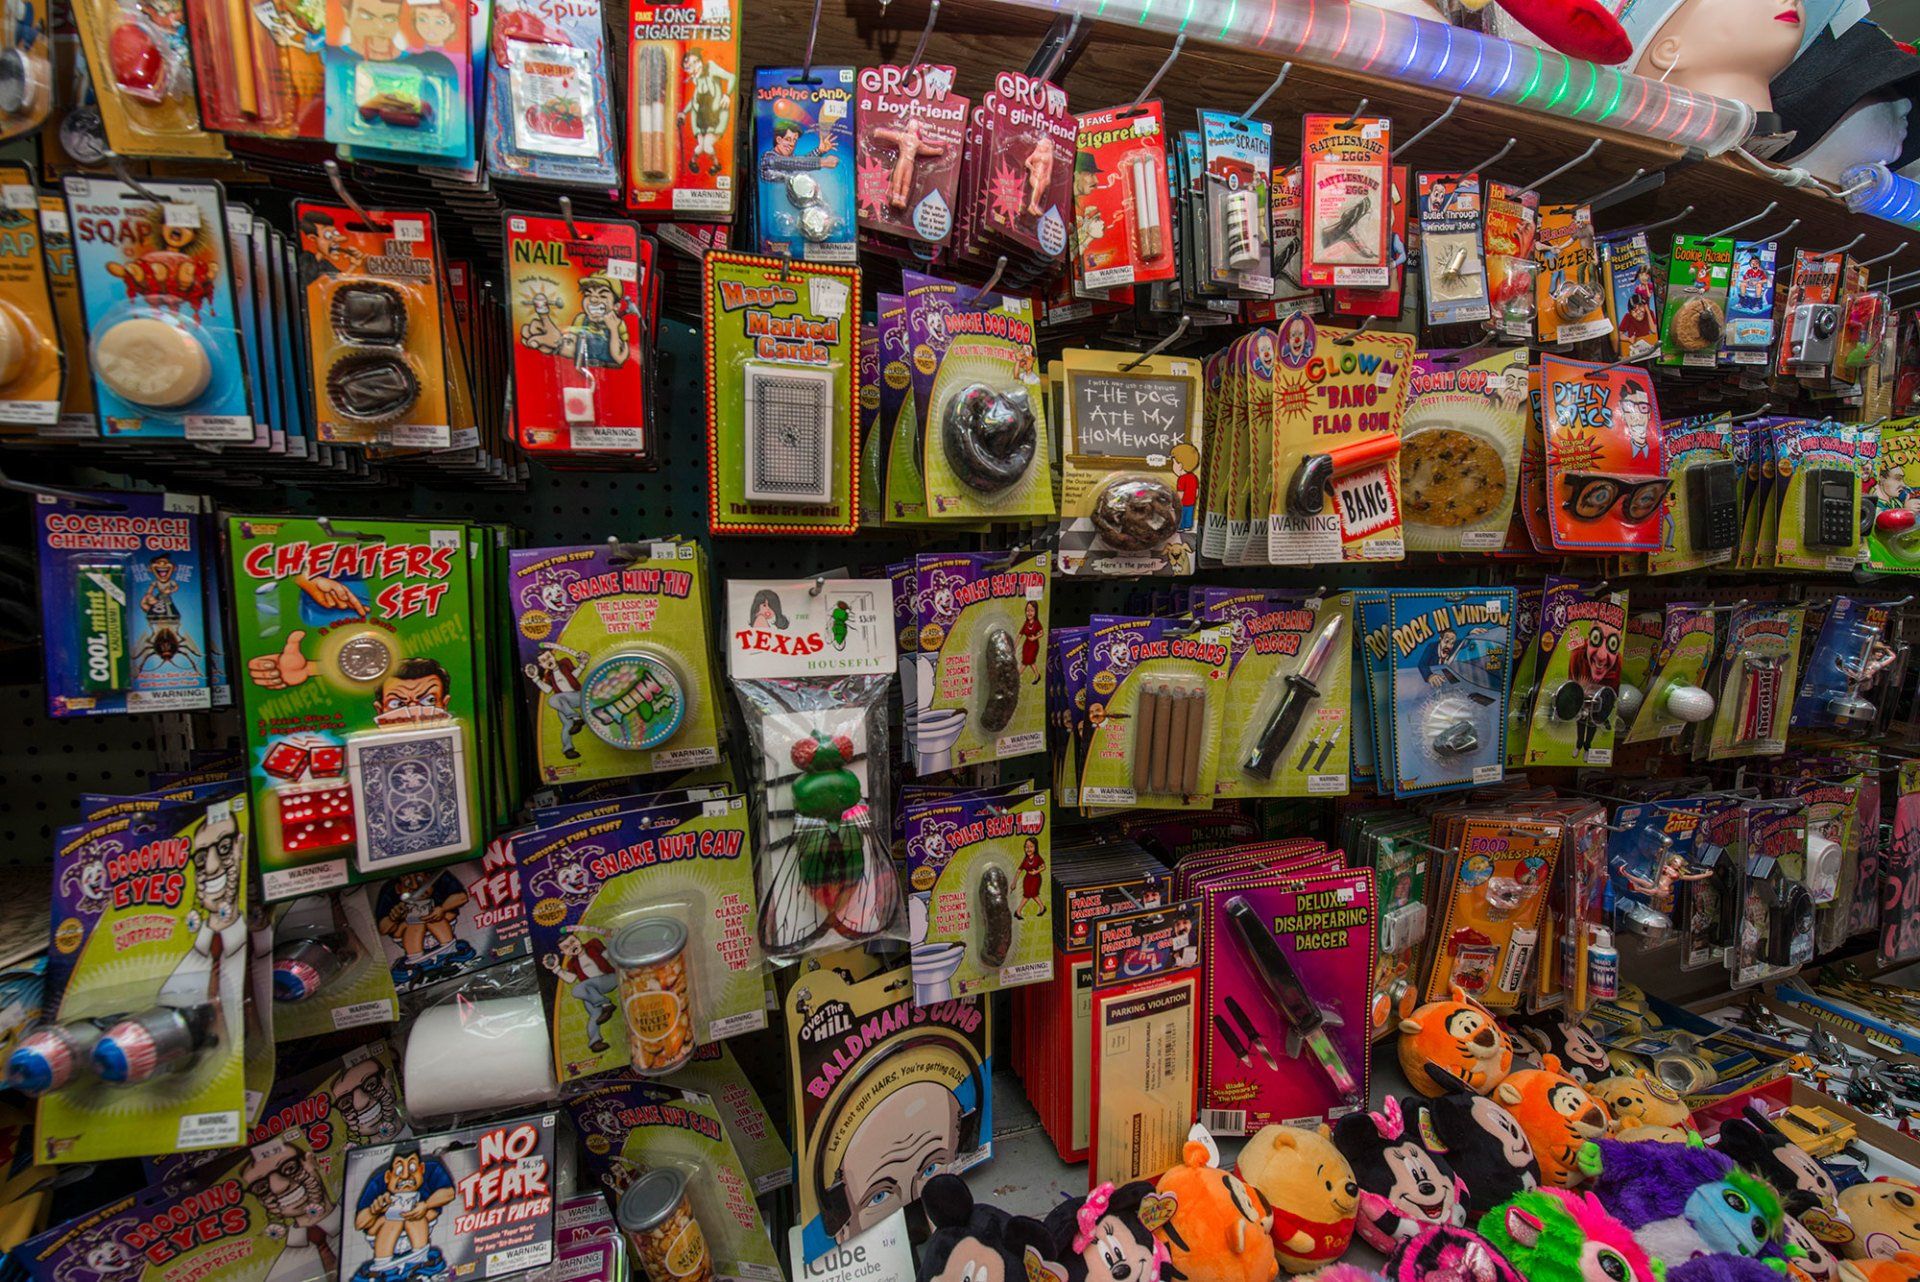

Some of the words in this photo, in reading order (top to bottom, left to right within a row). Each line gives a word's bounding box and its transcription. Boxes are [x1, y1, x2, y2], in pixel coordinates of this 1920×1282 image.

[635, 11, 653, 22] FAKE
[654, 8, 696, 23] LONG
[635, 25, 731, 41] CIGARETTES
[861, 69, 951, 101] GROW
[999, 75, 1067, 119] GROW
[861, 99, 872, 111] a
[878, 96, 964, 121] boyfriend
[998, 106, 1006, 116] a
[1011, 109, 1077, 142] girlfriend
[1086, 114, 1112, 126] FAKE
[1076, 121, 1160, 149] Cigarets
[1236, 134, 1269, 154] SCRATCH
[1310, 136, 1384, 154] RATTLESNAKE
[1342, 151, 1371, 161] EGGS
[1317, 174, 1379, 190] RATTLESNAKE
[1345, 185, 1369, 195] EGGS
[1490, 185, 1505, 199] Hot
[690, 191, 729, 199] WARNING:
[76, 204, 120, 216] BLOOD
[124, 206, 149, 217] RED
[1423, 211, 1444, 219] Bullet
[1447, 211, 1478, 220] Through
[77, 218, 152, 246] SOAP
[1426, 223, 1455, 232] Window
[1457, 222, 1476, 230] Joke
[1487, 216, 1507, 231] Candy
[386, 240, 414, 257] FAKE
[513, 240, 570, 267] NAIL
[1675, 247, 1702, 261] Cookie
[1705, 249, 1730, 263] Roach
[366, 257, 432, 276] CHOCOLATES
[1100, 266, 1133, 276] WARNING:
[1536, 249, 1595, 274] BUZZER
[1614, 258, 1645, 271] PENCIL
[1796, 273, 1835, 286] CAMERA
[720, 282, 797, 311] Magic
[746, 311, 839, 344] Marked
[946, 314, 985, 334] DOGGIE
[983, 313, 1008, 336] DOO
[1008, 318, 1031, 342] DOO
[756, 337, 829, 363] Cards
[1411, 370, 1457, 393] VOMIT
[1084, 388, 1131, 404] THE
[1136, 392, 1180, 407] DOG
[1089, 406, 1134, 426] ATE
[1313, 412, 1352, 434] FLAG
[1359, 412, 1389, 432] GUN
[1556, 407, 1613, 428] SPECS
[1078, 427, 1185, 449] HOMEWORK
[730, 504, 749, 516] The
[753, 504, 779, 516] cards
[801, 505, 840, 518] marked!
[1344, 481, 1388, 522] BANG
[46, 514, 190, 536] COCKROACH
[1272, 516, 1340, 531] WARNING:
[49, 533, 140, 549] CHEWING
[146, 534, 191, 551] GUM
[244, 540, 452, 579] CHEATERS
[517, 558, 550, 578] FORUM'S
[551, 555, 570, 564] FUN
[571, 551, 595, 561] STUFF
[1100, 560, 1123, 570] Here's
[1125, 562, 1136, 570] the
[1139, 561, 1156, 571] proof!
[567, 574, 619, 601] SNAKE
[623, 570, 659, 593] MINT
[662, 571, 693, 598] TIN
[955, 577, 989, 605] TOILET
[990, 572, 1018, 596] SEAT
[86, 590, 106, 632] mint
[375, 583, 449, 619] SET
[595, 601, 610, 611] THE
[612, 600, 641, 612] CLASSIC
[643, 598, 659, 609] GAG
[601, 611, 619, 622] THAT
[621, 611, 640, 621] GETS
[608, 621, 632, 633] EVERY
[634, 620, 651, 631] TIME
[1247, 610, 1315, 633] DISAPPEARING
[403, 615, 468, 656] WINNER!
[1393, 619, 1432, 657] ROCK
[1432, 609, 1451, 630] IN
[1453, 604, 1510, 627] WINDOW
[736, 629, 825, 656] TEXAS
[1130, 641, 1168, 660] FAKE
[1172, 641, 1226, 664] CIGARS
[1254, 633, 1301, 655] DAGGER
[808, 657, 881, 670] HOUSEFLY
[152, 690, 206, 699] WARNING:
[258, 681, 331, 721] WINNER!
[670, 748, 713, 758] WARNING:
[1664, 818, 1698, 834] GIRLS
[590, 843, 655, 880] SNAKE
[659, 835, 696, 859] NUT
[700, 830, 743, 856] CAN
[1469, 837, 1510, 851] FOOD
[108, 836, 192, 882] DROOPING
[289, 865, 332, 880] WARNING:
[113, 873, 184, 908] EYES
[1274, 908, 1368, 935] DISAPPEARING
[115, 927, 173, 951] SURPRISE!
[1101, 936, 1141, 953] PARKING
[1102, 926, 1133, 943] FAKE
[1295, 935, 1348, 951] DAGGER
[1111, 1003, 1145, 1017] PARKING
[1148, 992, 1187, 1009] VIOLATION
[635, 1012, 669, 1024] MIXED
[639, 1021, 669, 1033] NUTS
[801, 1012, 825, 1039] Over
[826, 1003, 843, 1017] The
[807, 1002, 927, 1099] BALDMAN'S
[930, 1000, 982, 1033] COMB
[830, 1132, 846, 1152] Let's
[845, 1111, 856, 1129] not
[856, 1092, 871, 1115] split
[901, 1064, 925, 1076] You're
[925, 1063, 947, 1073] getting
[618, 1106, 661, 1128] SNAKE
[663, 1106, 688, 1128] NUT
[690, 1112, 722, 1141] CAN
[479, 1123, 537, 1167] NO
[522, 1159, 543, 1169] $6.99
[458, 1163, 548, 1209] TEAR
[123, 1179, 243, 1250] DROOPING
[454, 1206, 505, 1235] TOILET
[507, 1198, 551, 1223] PAPER
[146, 1208, 249, 1265] EYES
[855, 1261, 881, 1277] cube
